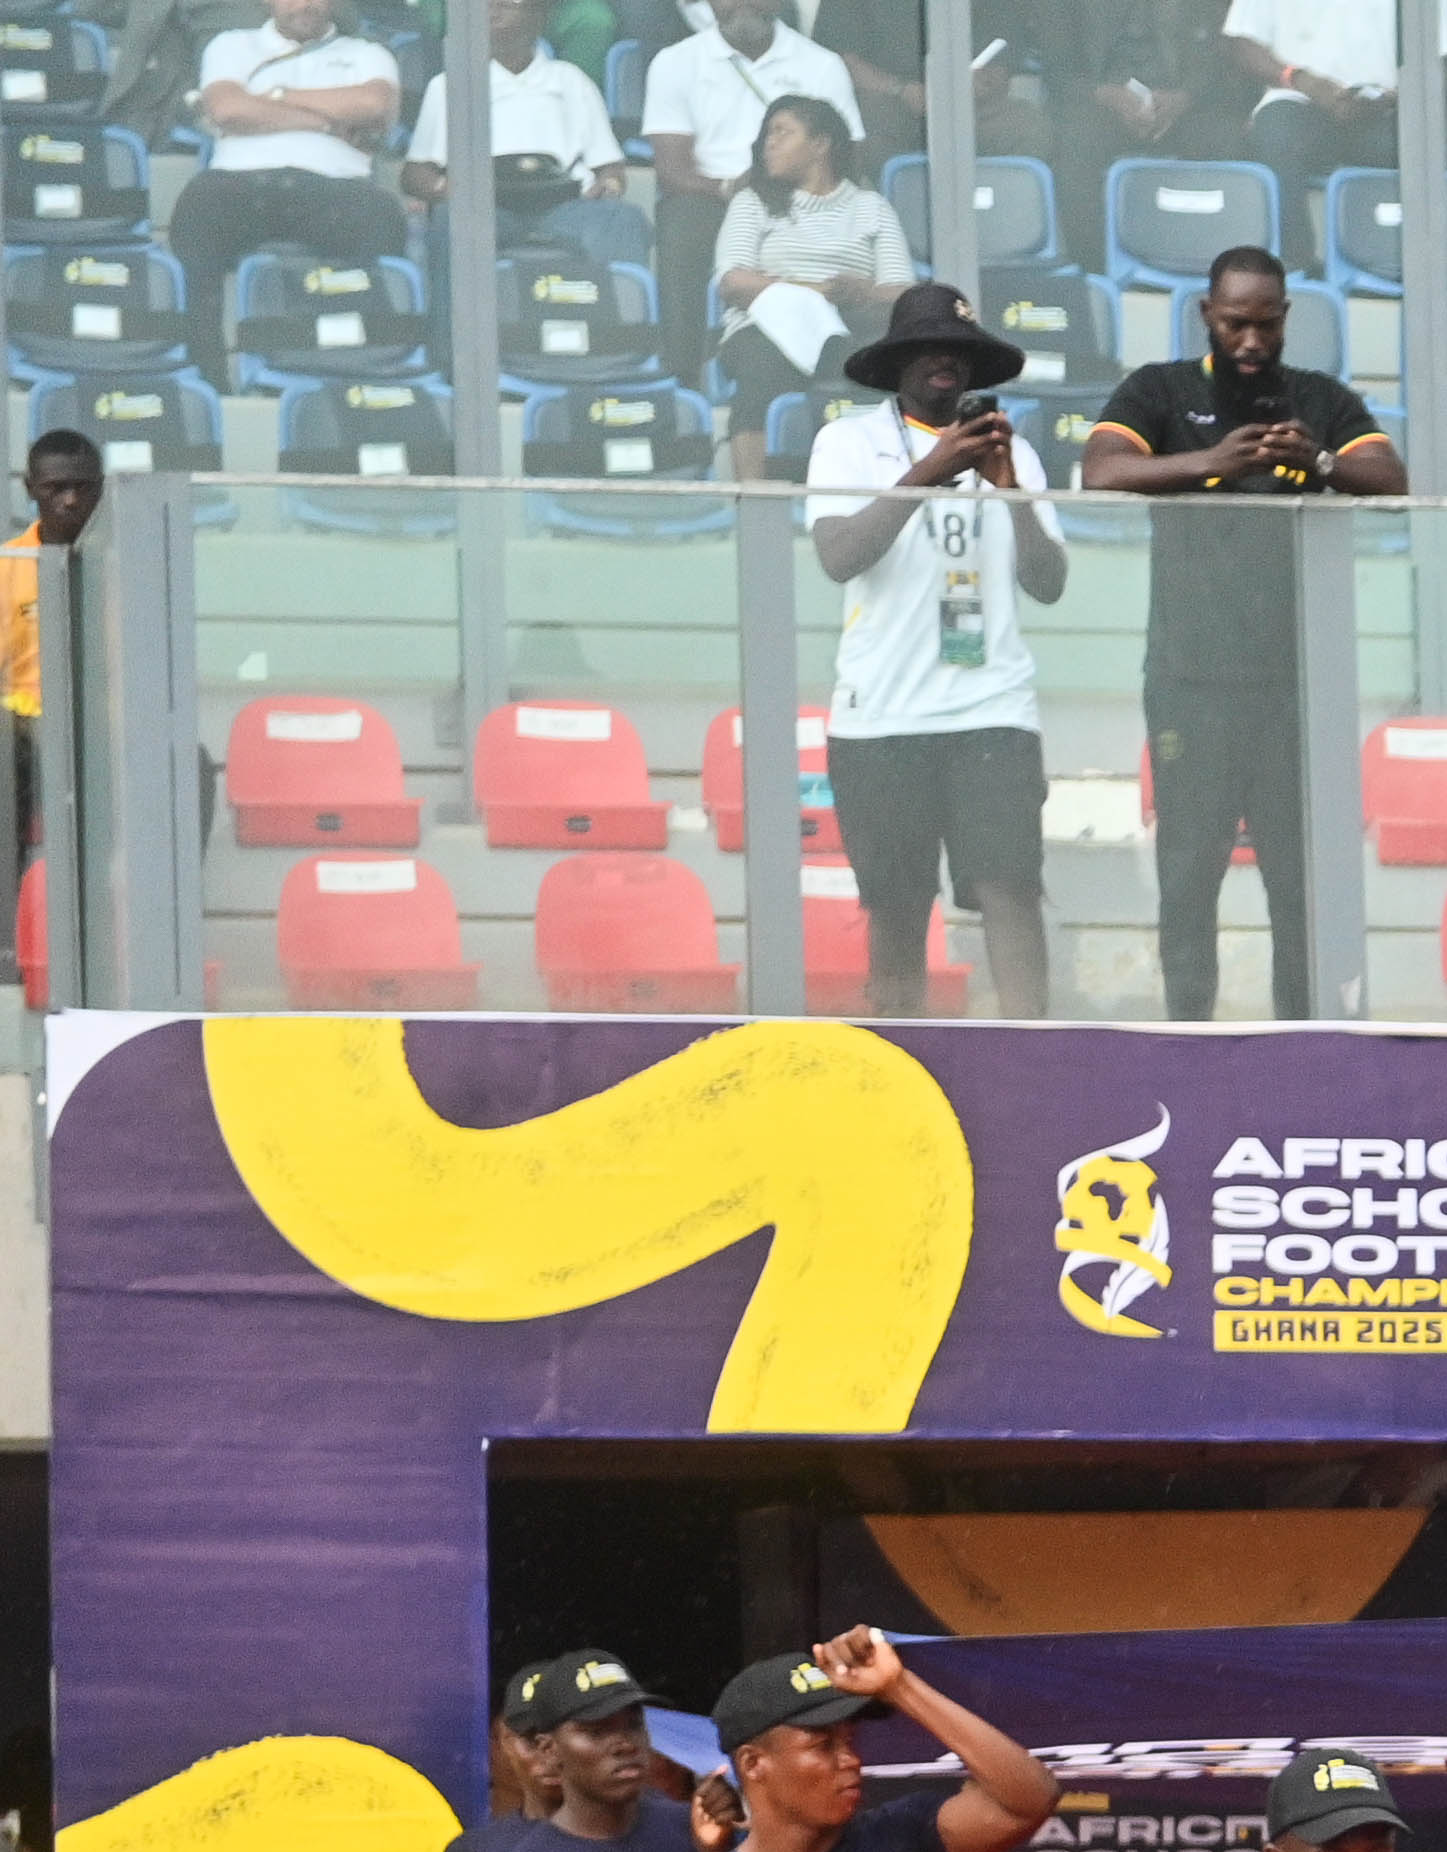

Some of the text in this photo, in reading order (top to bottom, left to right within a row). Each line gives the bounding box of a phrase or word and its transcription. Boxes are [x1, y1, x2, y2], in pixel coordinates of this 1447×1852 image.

[943, 513, 966, 557] 8
[1230, 1318, 1342, 1344] GHANA
[1355, 1318, 1444, 1344] 2025
[1028, 1814, 1270, 1847] AFRICA
